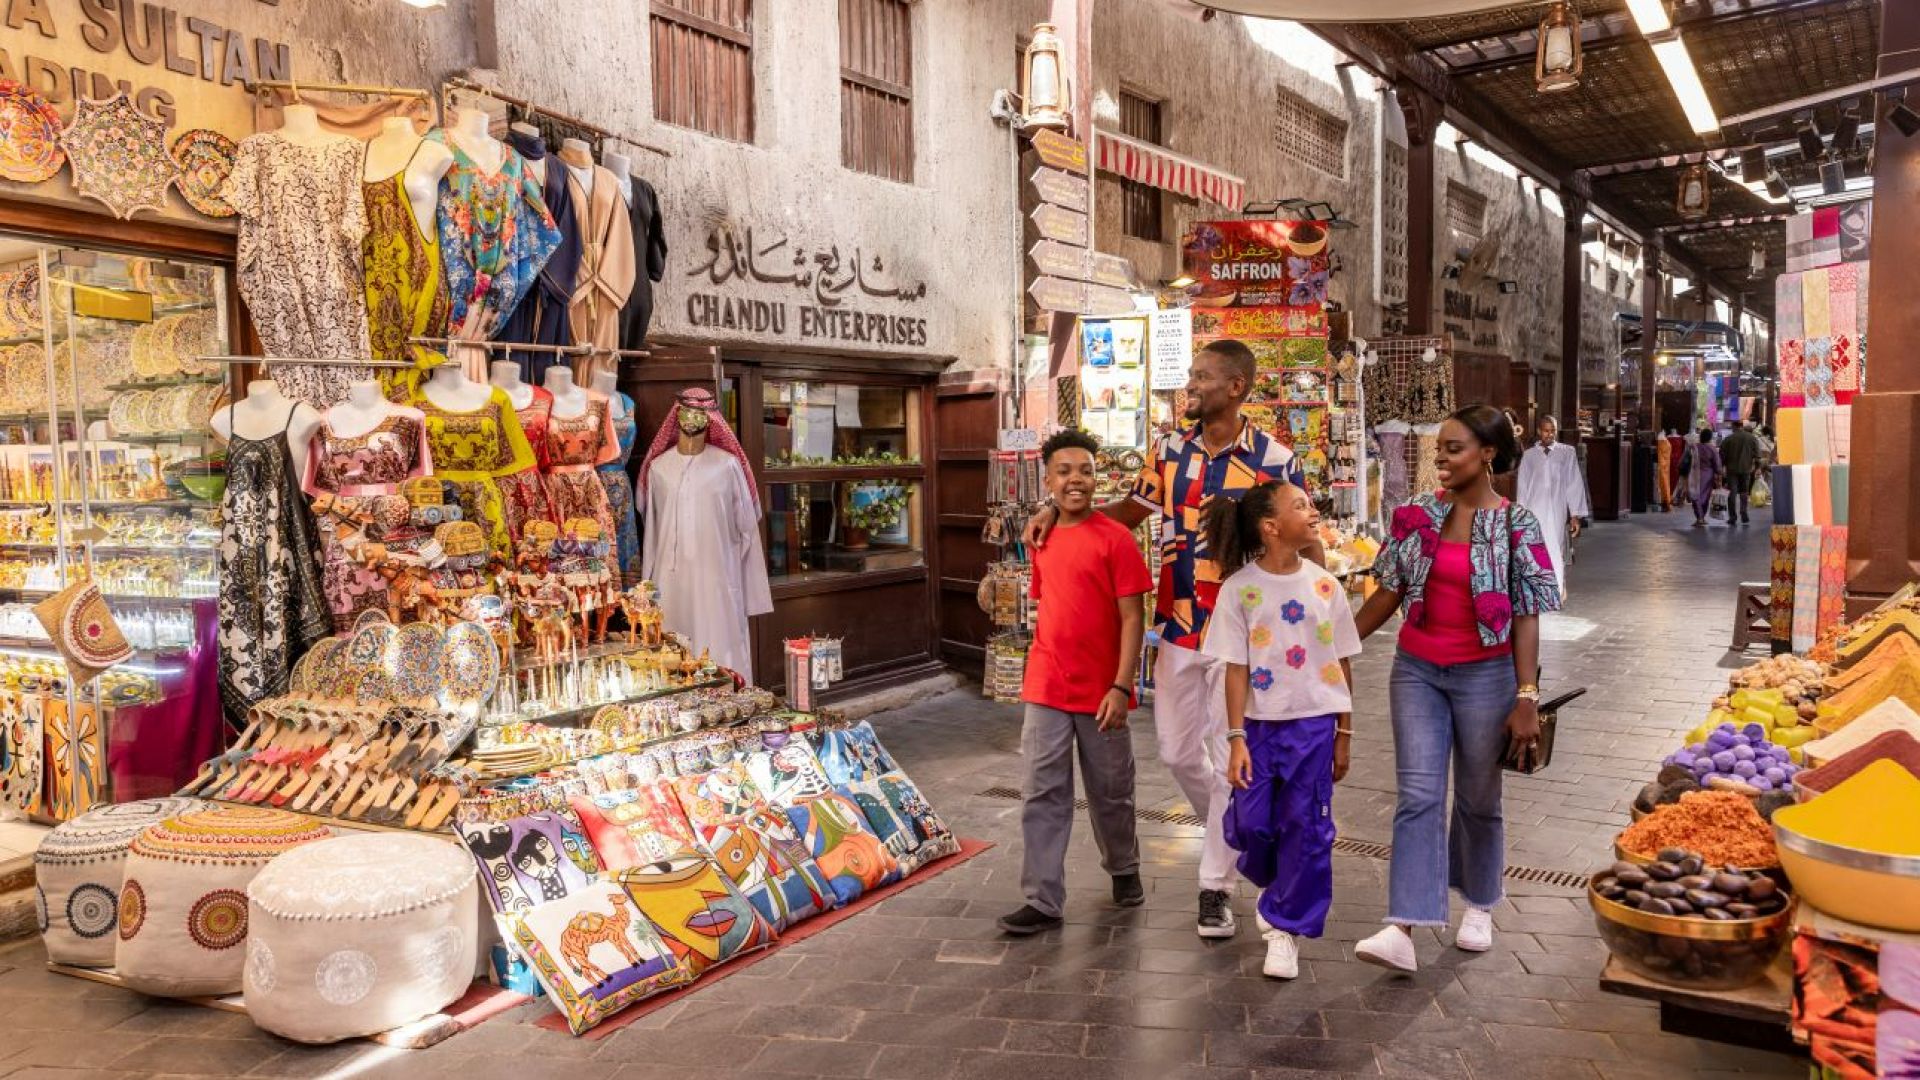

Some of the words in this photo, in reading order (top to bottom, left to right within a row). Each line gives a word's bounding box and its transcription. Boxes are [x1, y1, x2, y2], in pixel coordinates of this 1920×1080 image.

[81, 0, 291, 93] SULTAN
[814, 243, 927, 306] مشاريع
[1211, 262, 1282, 281] SAFFRON
[687, 292, 786, 334] CHANDU
[800, 305, 927, 346] ENTERPRISES
